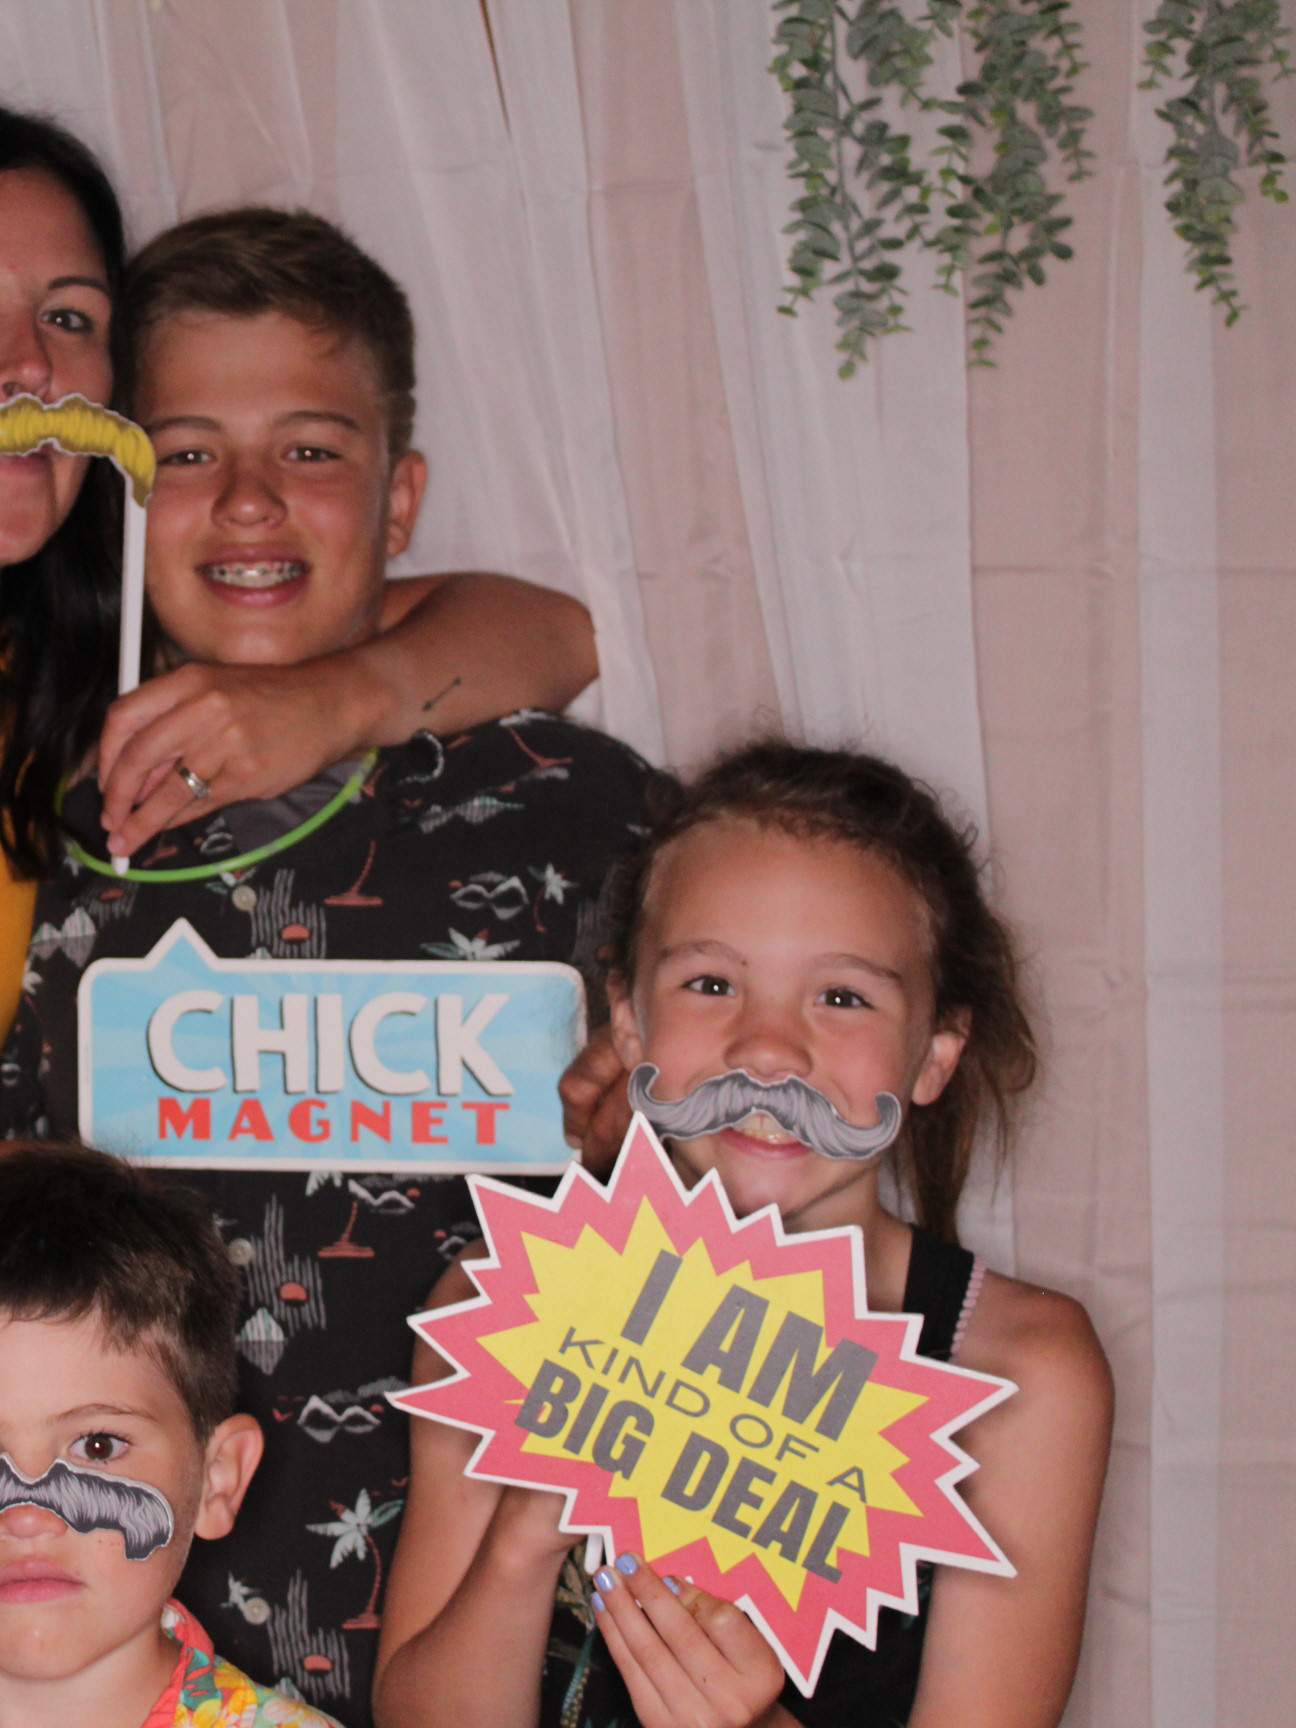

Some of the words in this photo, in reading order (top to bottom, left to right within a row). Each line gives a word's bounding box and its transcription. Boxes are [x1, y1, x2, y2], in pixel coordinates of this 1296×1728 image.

[146, 989, 515, 1096] CHICK
[158, 1097, 510, 1145] MAGNET
[558, 1326, 711, 1418] KIND
[729, 1413, 820, 1465] OF
[826, 1465, 868, 1503] A
[620, 1249, 683, 1345] I
[681, 1284, 879, 1442] AM
[514, 1358, 656, 1482] BIG
[661, 1431, 851, 1585] DEAL
